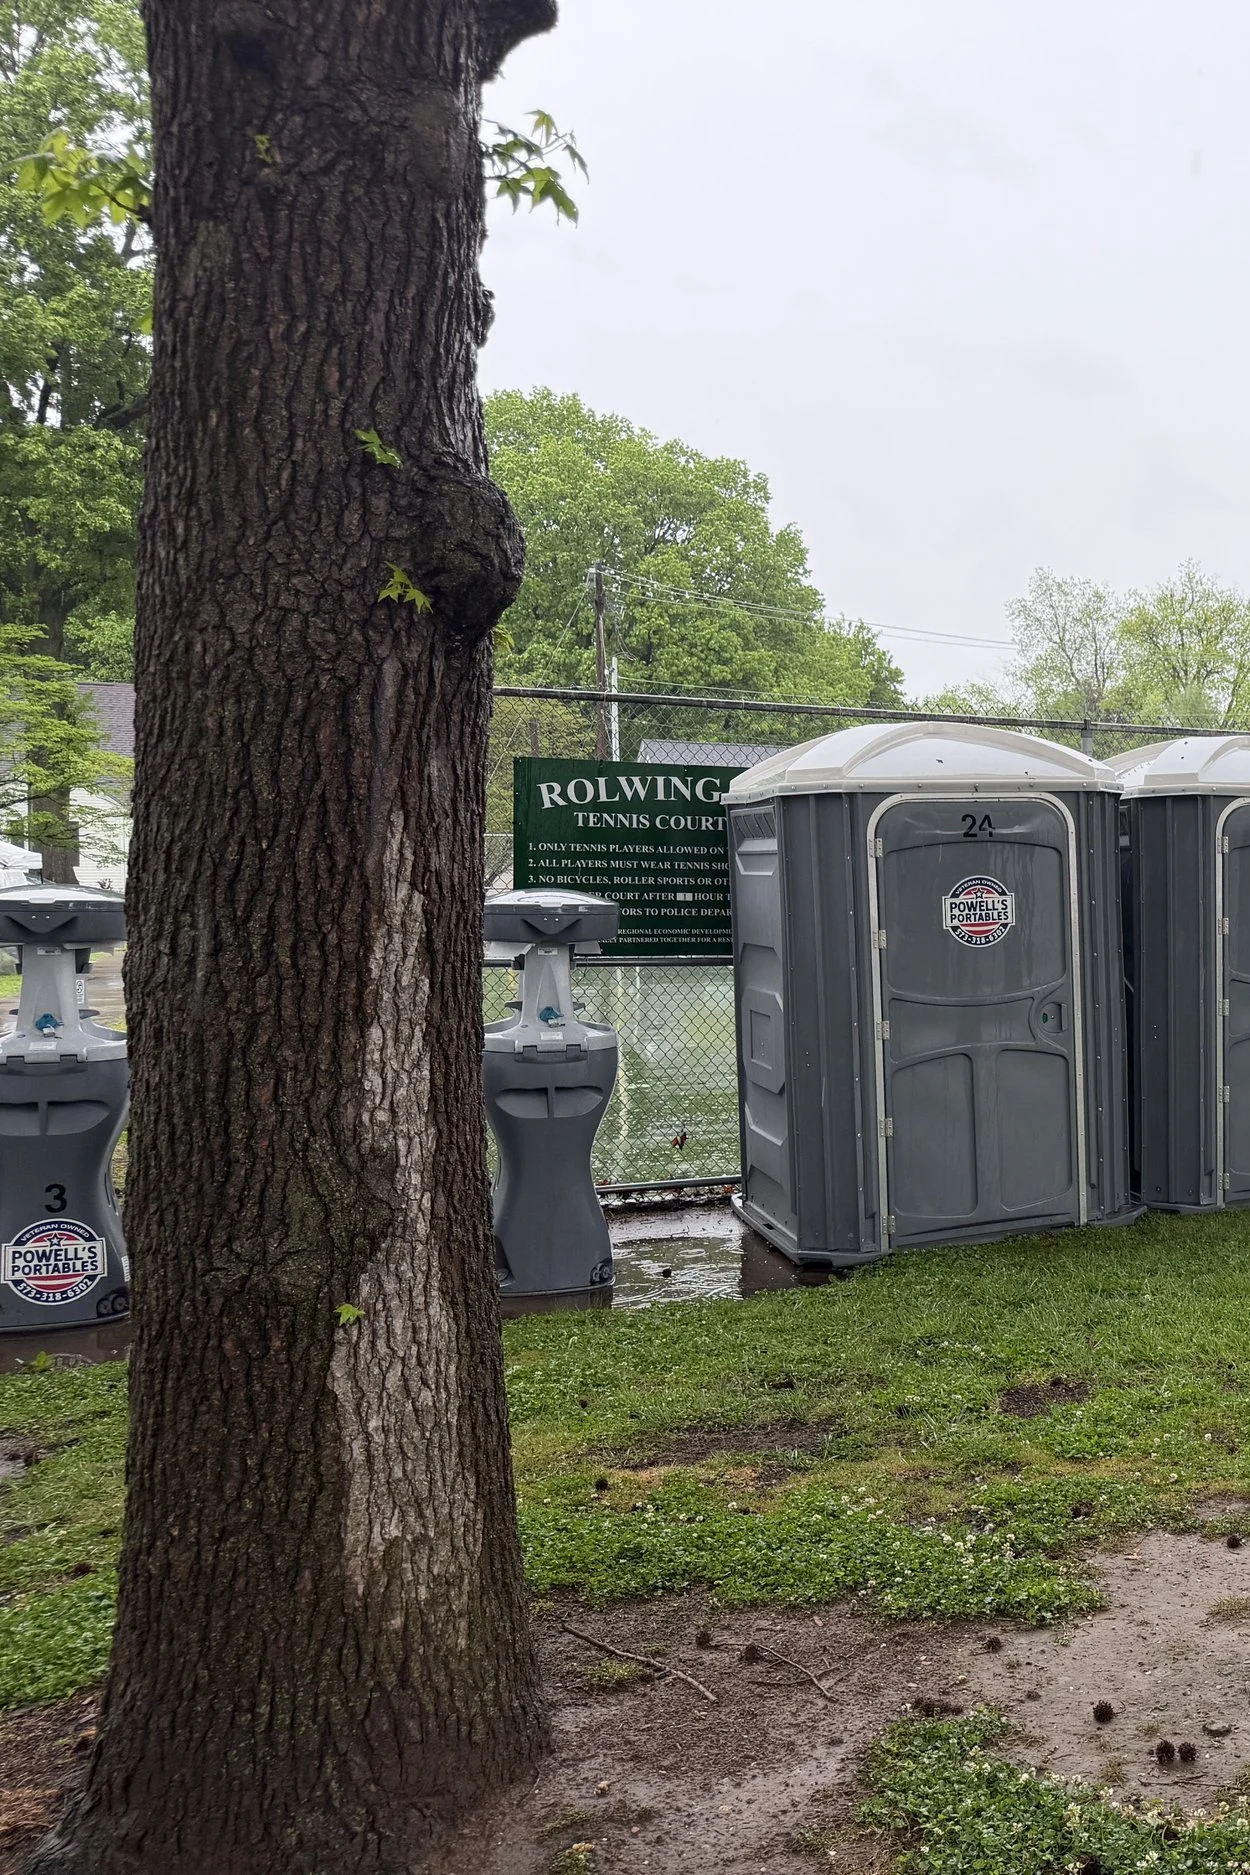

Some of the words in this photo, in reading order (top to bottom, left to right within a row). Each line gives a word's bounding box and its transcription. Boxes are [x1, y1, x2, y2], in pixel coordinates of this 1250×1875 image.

[536, 775, 722, 809] ROLWING
[574, 811, 650, 829] TENNIS
[961, 814, 996, 838] 24
[528, 843, 537, 851] 1.
[538, 843, 568, 852] ONLY
[569, 843, 607, 852] TENNIS
[609, 844, 655, 854] PLAYERS
[656, 845, 708, 855] ALLOWED
[709, 846, 724, 855] ON
[528, 859, 537, 867] 2.
[538, 859, 559, 868] ALL
[561, 860, 608, 869] PLAYERS
[609, 860, 639, 869] MUST
[640, 861, 671, 869] WEAR
[673, 861, 710, 870] TENNIS
[528, 875, 537, 883] 3.
[538, 875, 555, 884] NO
[556, 875, 611, 885] BICYCLES,
[613, 876, 655, 885] ROLLER
[657, 877, 696, 886] SPORTS
[697, 877, 712, 886] OR
[955, 879, 981, 895] VETERAN
[981, 879, 1003, 894] OWNED
[604, 891, 640, 900] COURT
[642, 892, 675, 901] AFTER
[694, 892, 724, 901] HOUR
[620, 907, 643, 916] ORS
[644, 908, 659, 916] TO
[660, 908, 698, 916] POLICE
[949, 899, 1009, 914] POWELL'S
[950, 911, 1009, 923] PORTABLES
[954, 926, 1006, 944] 573-318-6302
[45, 1183, 68, 1213] 3
[20, 1223, 59, 1243] VETERAN
[60, 1223, 90, 1238] OWNED
[11, 1245, 98, 1265] POWELL'S
[11, 1259, 98, 1277] PORTABLES
[17, 1278, 93, 1301] 573-318-6302
